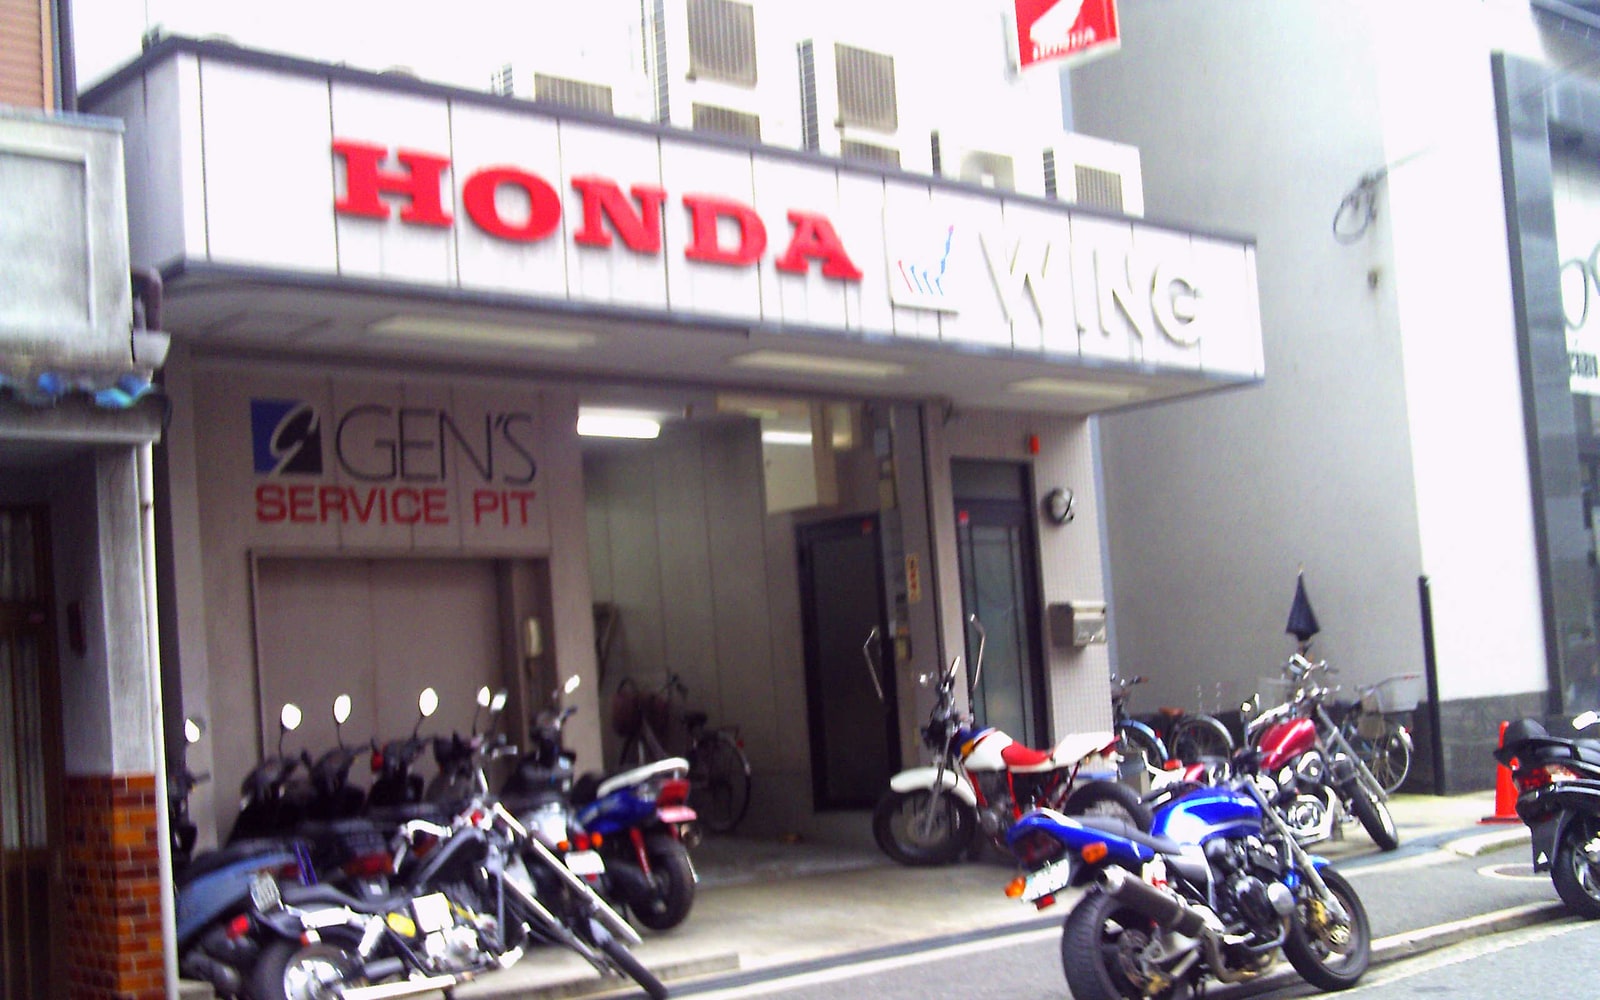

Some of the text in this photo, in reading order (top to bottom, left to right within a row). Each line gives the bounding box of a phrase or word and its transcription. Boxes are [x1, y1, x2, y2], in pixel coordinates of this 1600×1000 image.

[332, 138, 1204, 347] HONDA WING
[336, 404, 537, 485] GEN'S
[255, 483, 537, 527] SERVICE PIT
